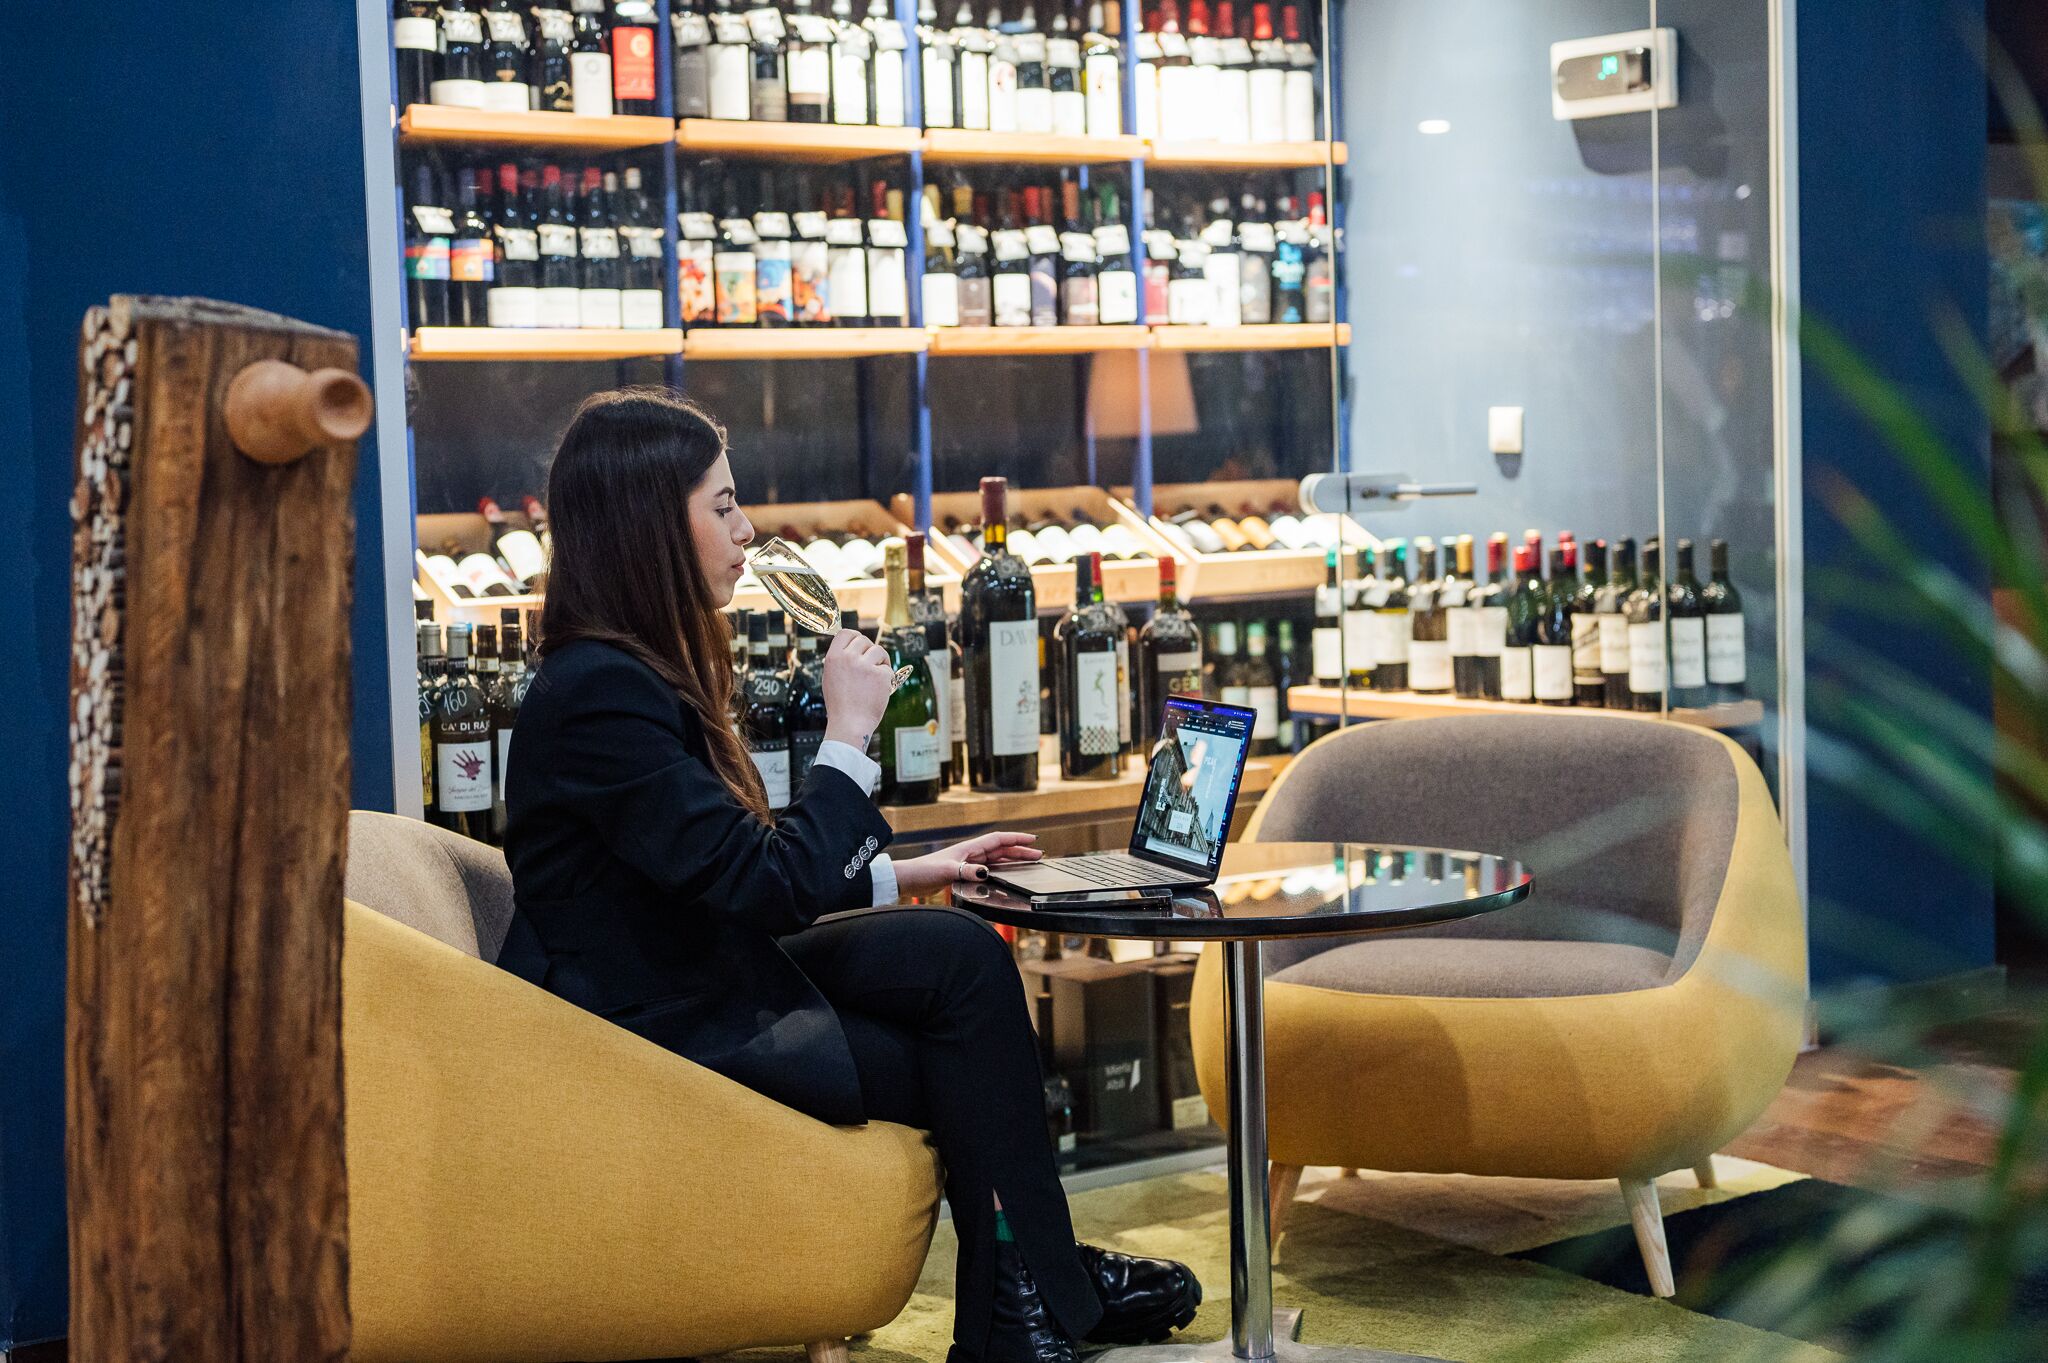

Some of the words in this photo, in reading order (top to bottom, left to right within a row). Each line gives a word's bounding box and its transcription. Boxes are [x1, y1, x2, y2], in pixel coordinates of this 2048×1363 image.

[511, 682, 531, 703] 16
[754, 678, 780, 696] 290
[443, 689, 468, 716] 160
[460, 722, 471, 731] DI
